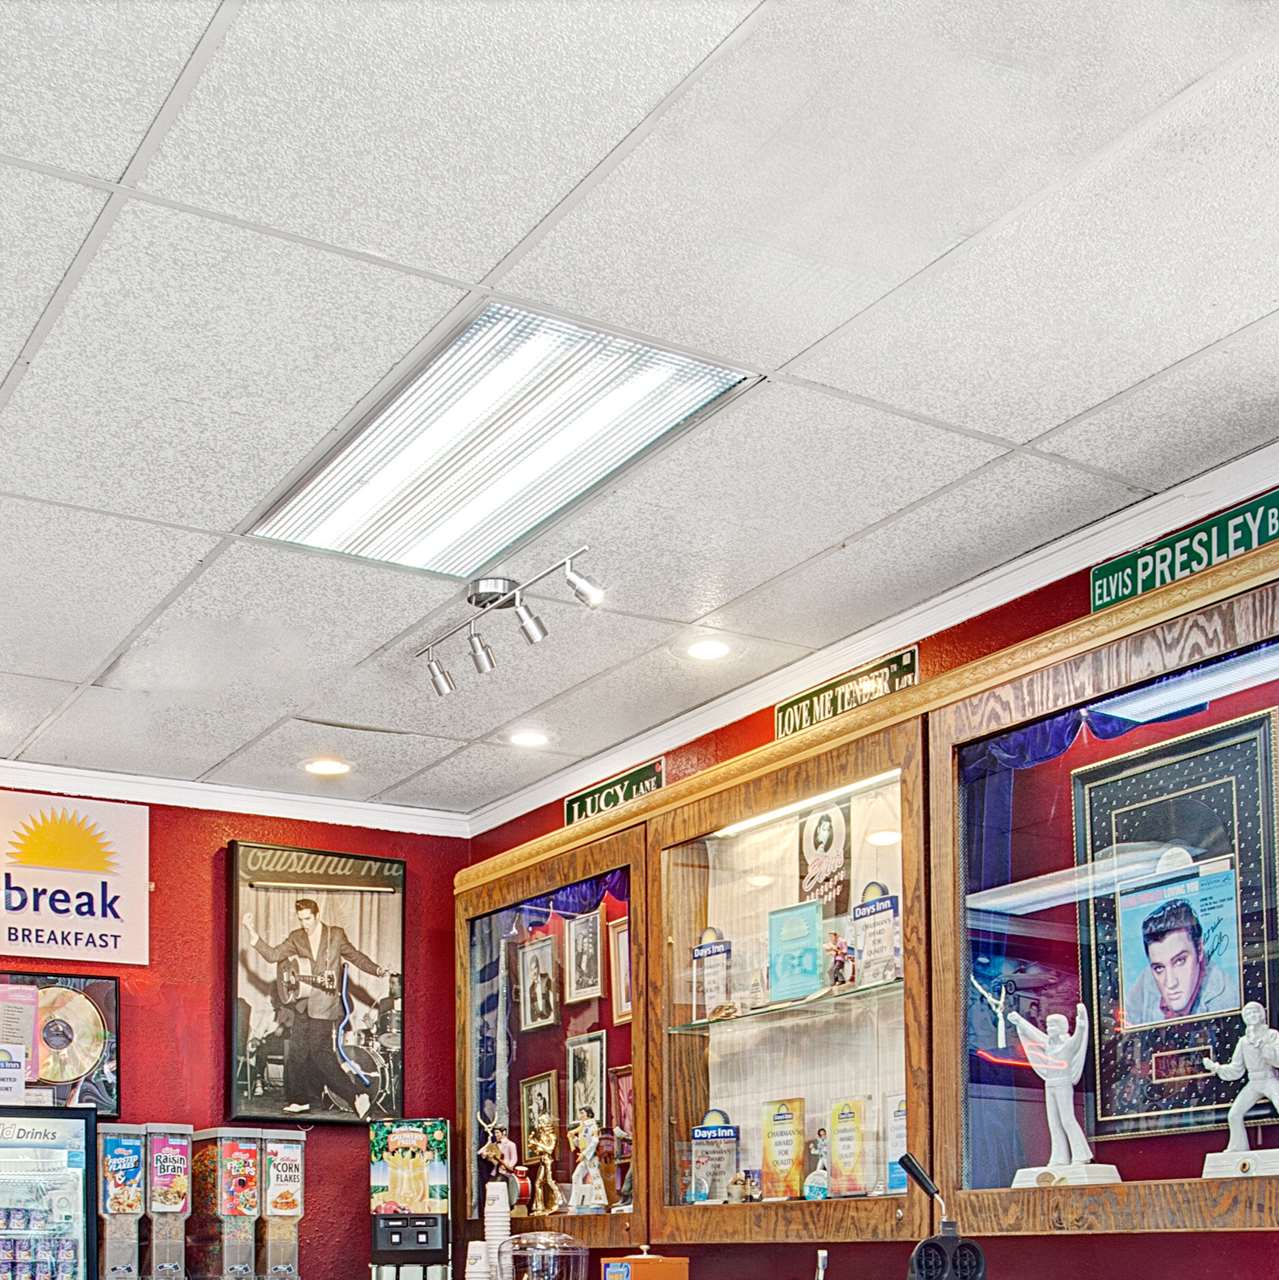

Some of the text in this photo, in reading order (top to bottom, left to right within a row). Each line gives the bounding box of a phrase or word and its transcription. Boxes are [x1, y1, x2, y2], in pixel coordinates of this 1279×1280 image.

[1094, 567, 1133, 607] ELVIS
[1136, 506, 1265, 595] PRESLEY
[776, 700, 811, 740] LOVE
[812, 689, 834, 725] ME
[834, 665, 891, 714] TENDER
[572, 776, 658, 825] LUCY LANE
[855, 899, 892, 918] Days Inn
[7, 926, 122, 950] BREAKFAST
[694, 944, 725, 958] Days Inn
[4, 1061, 21, 1069] Inn
[16, 1128, 57, 1141] Drinks
[694, 1128, 734, 1139] Days Inn
[155, 1153, 186, 1166] Raisin
[159, 1165, 183, 1174] Bran
[276, 1162, 300, 1173] CORN
[275, 1174, 300, 1183] FLAKES
